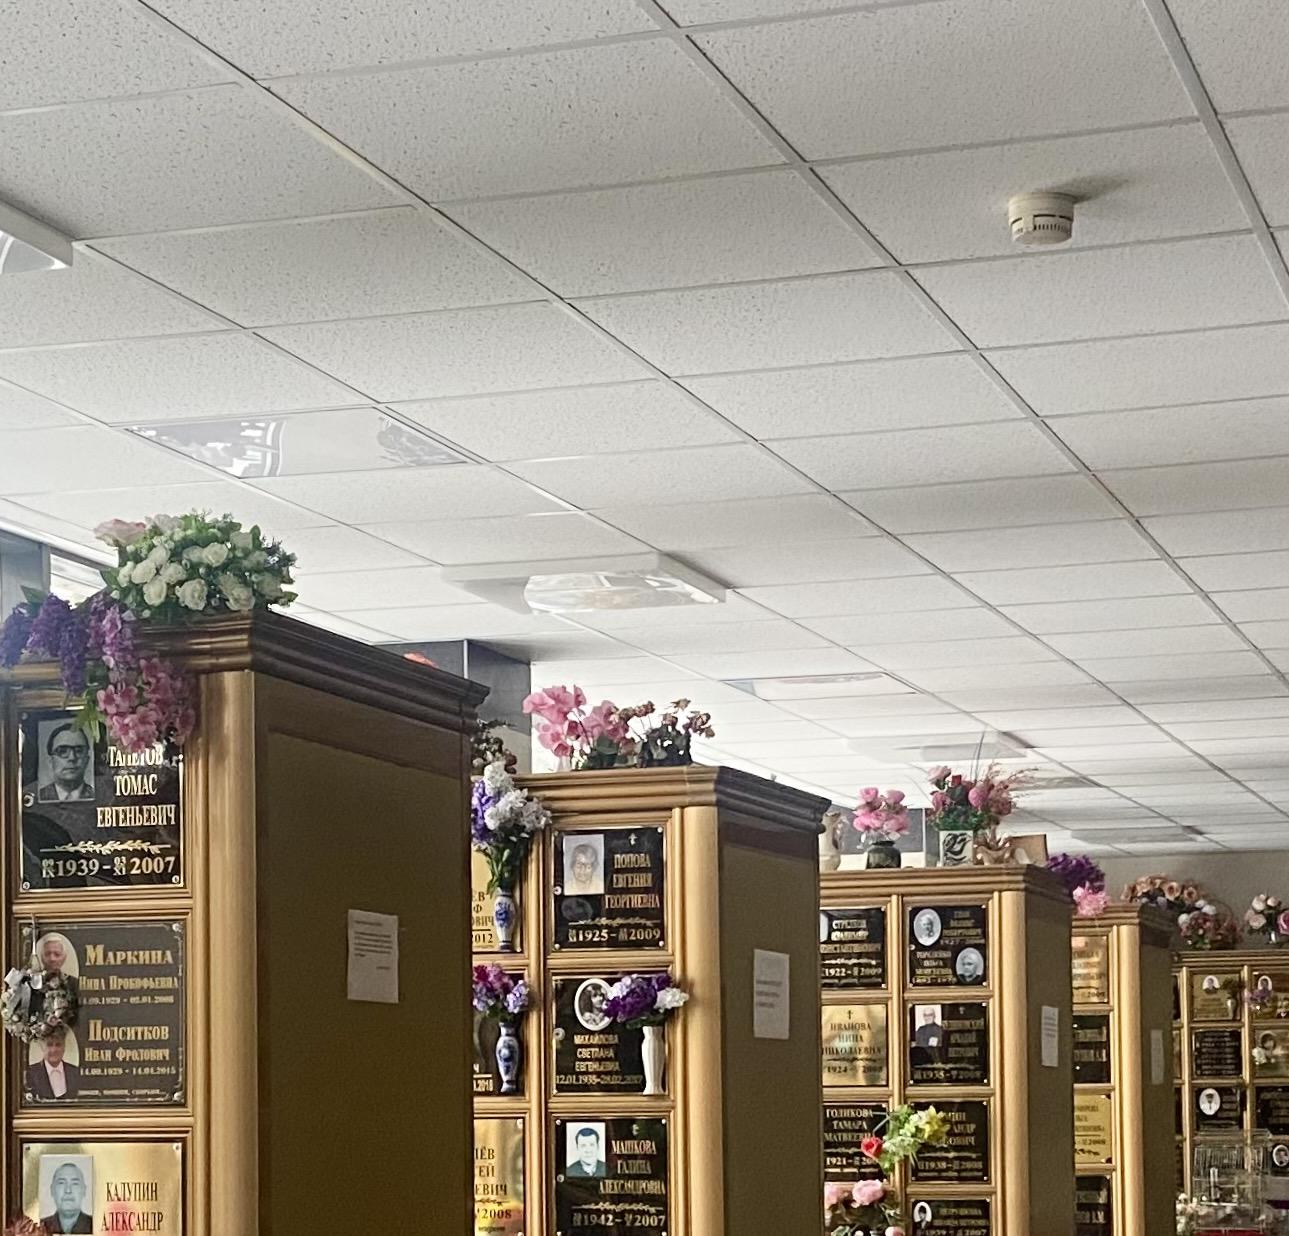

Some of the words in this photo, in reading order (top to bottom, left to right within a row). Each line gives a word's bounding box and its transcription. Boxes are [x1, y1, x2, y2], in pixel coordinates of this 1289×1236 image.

[113, 774, 158, 796] ТОМАС
[97, 806, 176, 828] ЕВГЕНЬЕВИЧ
[56, 858, 99, 876] 1939
[130, 856, 176, 874] 2007
[614, 853, 651, 868] ПОПОВА
[613, 873, 652, 888] ЕВГЕНИЯ
[605, 894, 660, 908] ГЕОРГИЕВНА
[579, 929, 608, 941] 1925
[629, 928, 660, 940] 2009
[825, 968, 845, 976] 1922
[826, 1109, 873, 1118] ГОЛИКОВА
[832, 1121, 868, 1129] ТАМАРА
[612, 1140, 657, 1155] МАШКОВА
[617, 1160, 652, 1174] ГАЛИНА
[826, 1157, 846, 1165] 1921
[106, 1181, 158, 1202] КАЛУПИН
[599, 1180, 666, 1194] АЛЕКСАНДРОВНА
[482, 1208, 512, 1219] 2008
[583, 1214, 614, 1226] 1942
[635, 1215, 665, 1226] 2007
[101, 1211, 163, 1233] АЛЕКСАНДР
